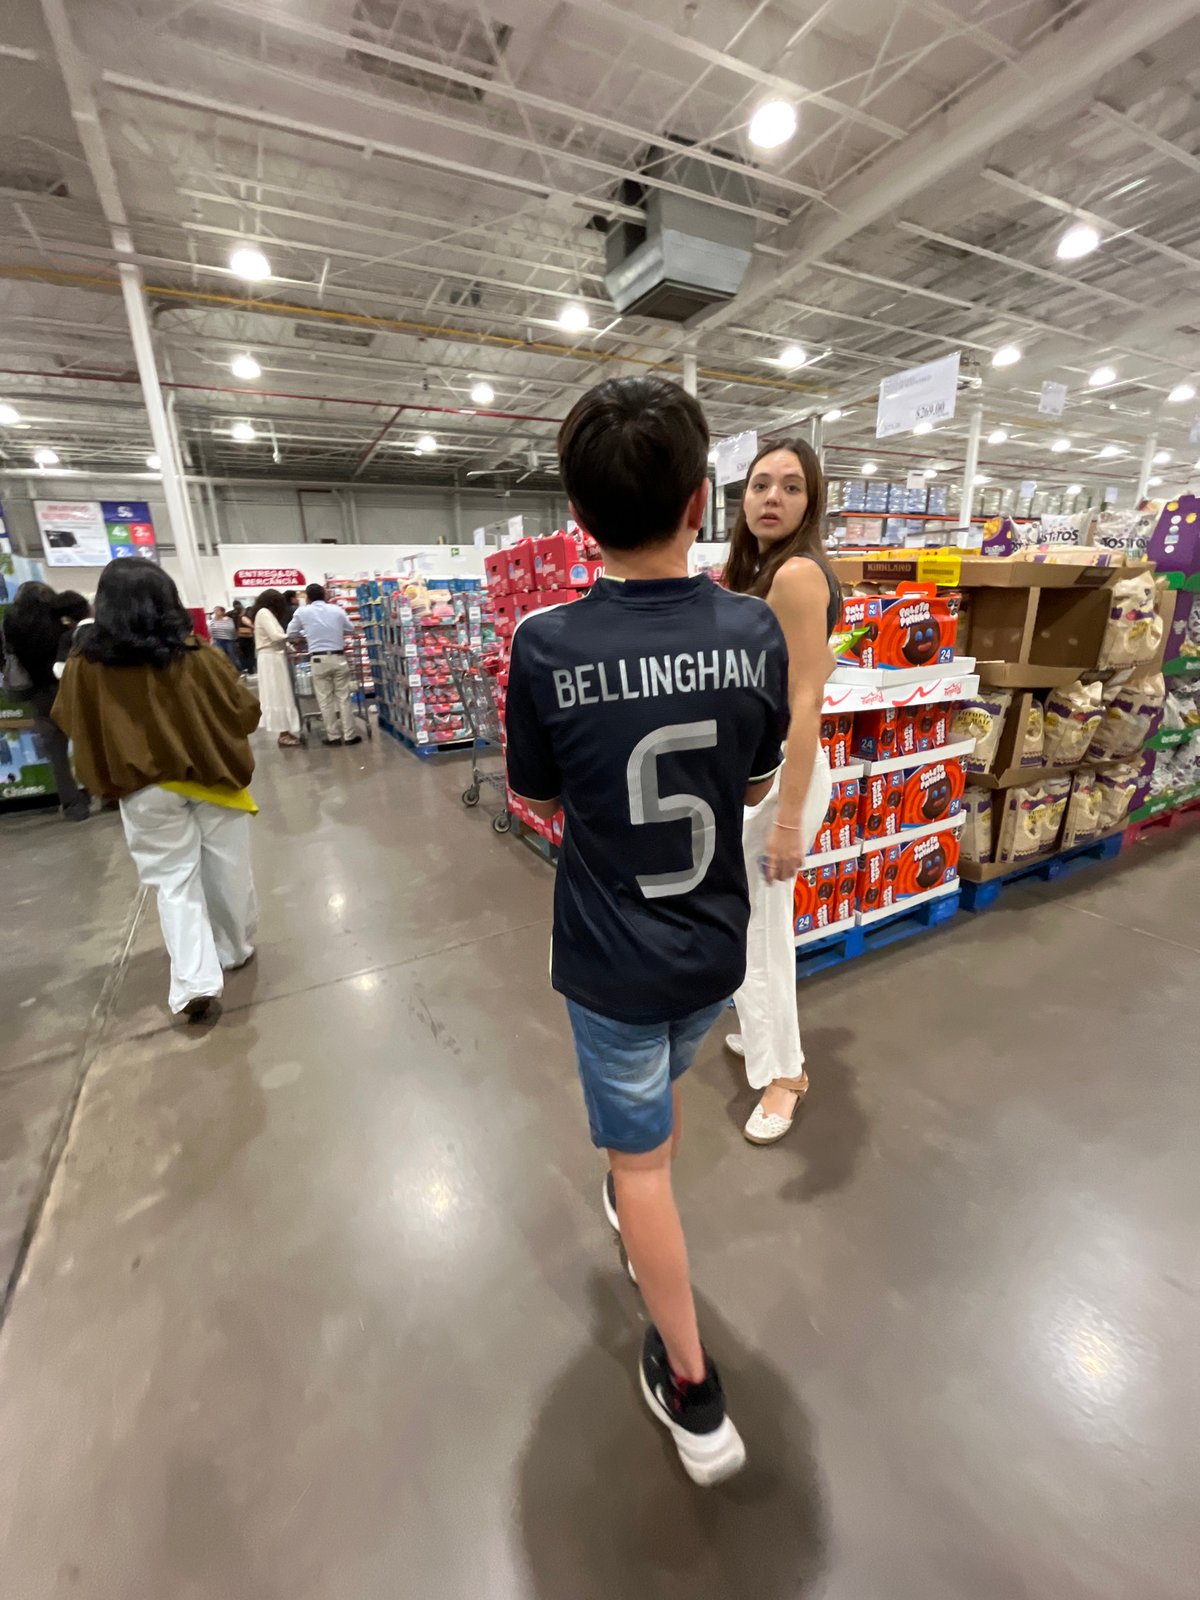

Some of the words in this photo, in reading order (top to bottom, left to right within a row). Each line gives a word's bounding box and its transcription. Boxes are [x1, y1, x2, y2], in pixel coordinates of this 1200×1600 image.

[867, 563, 912, 572] KIRKLAND
[239, 569, 284, 578] ENTREGA
[285, 569, 299, 578] DE
[940, 649, 951, 659] 24
[552, 649, 767, 709] BELLINGHAM
[861, 739, 873, 750] 24
[627, 719, 718, 899] 5
[949, 800, 960, 813] 24
[945, 868, 955, 879] 24
[799, 916, 810, 927] 24
